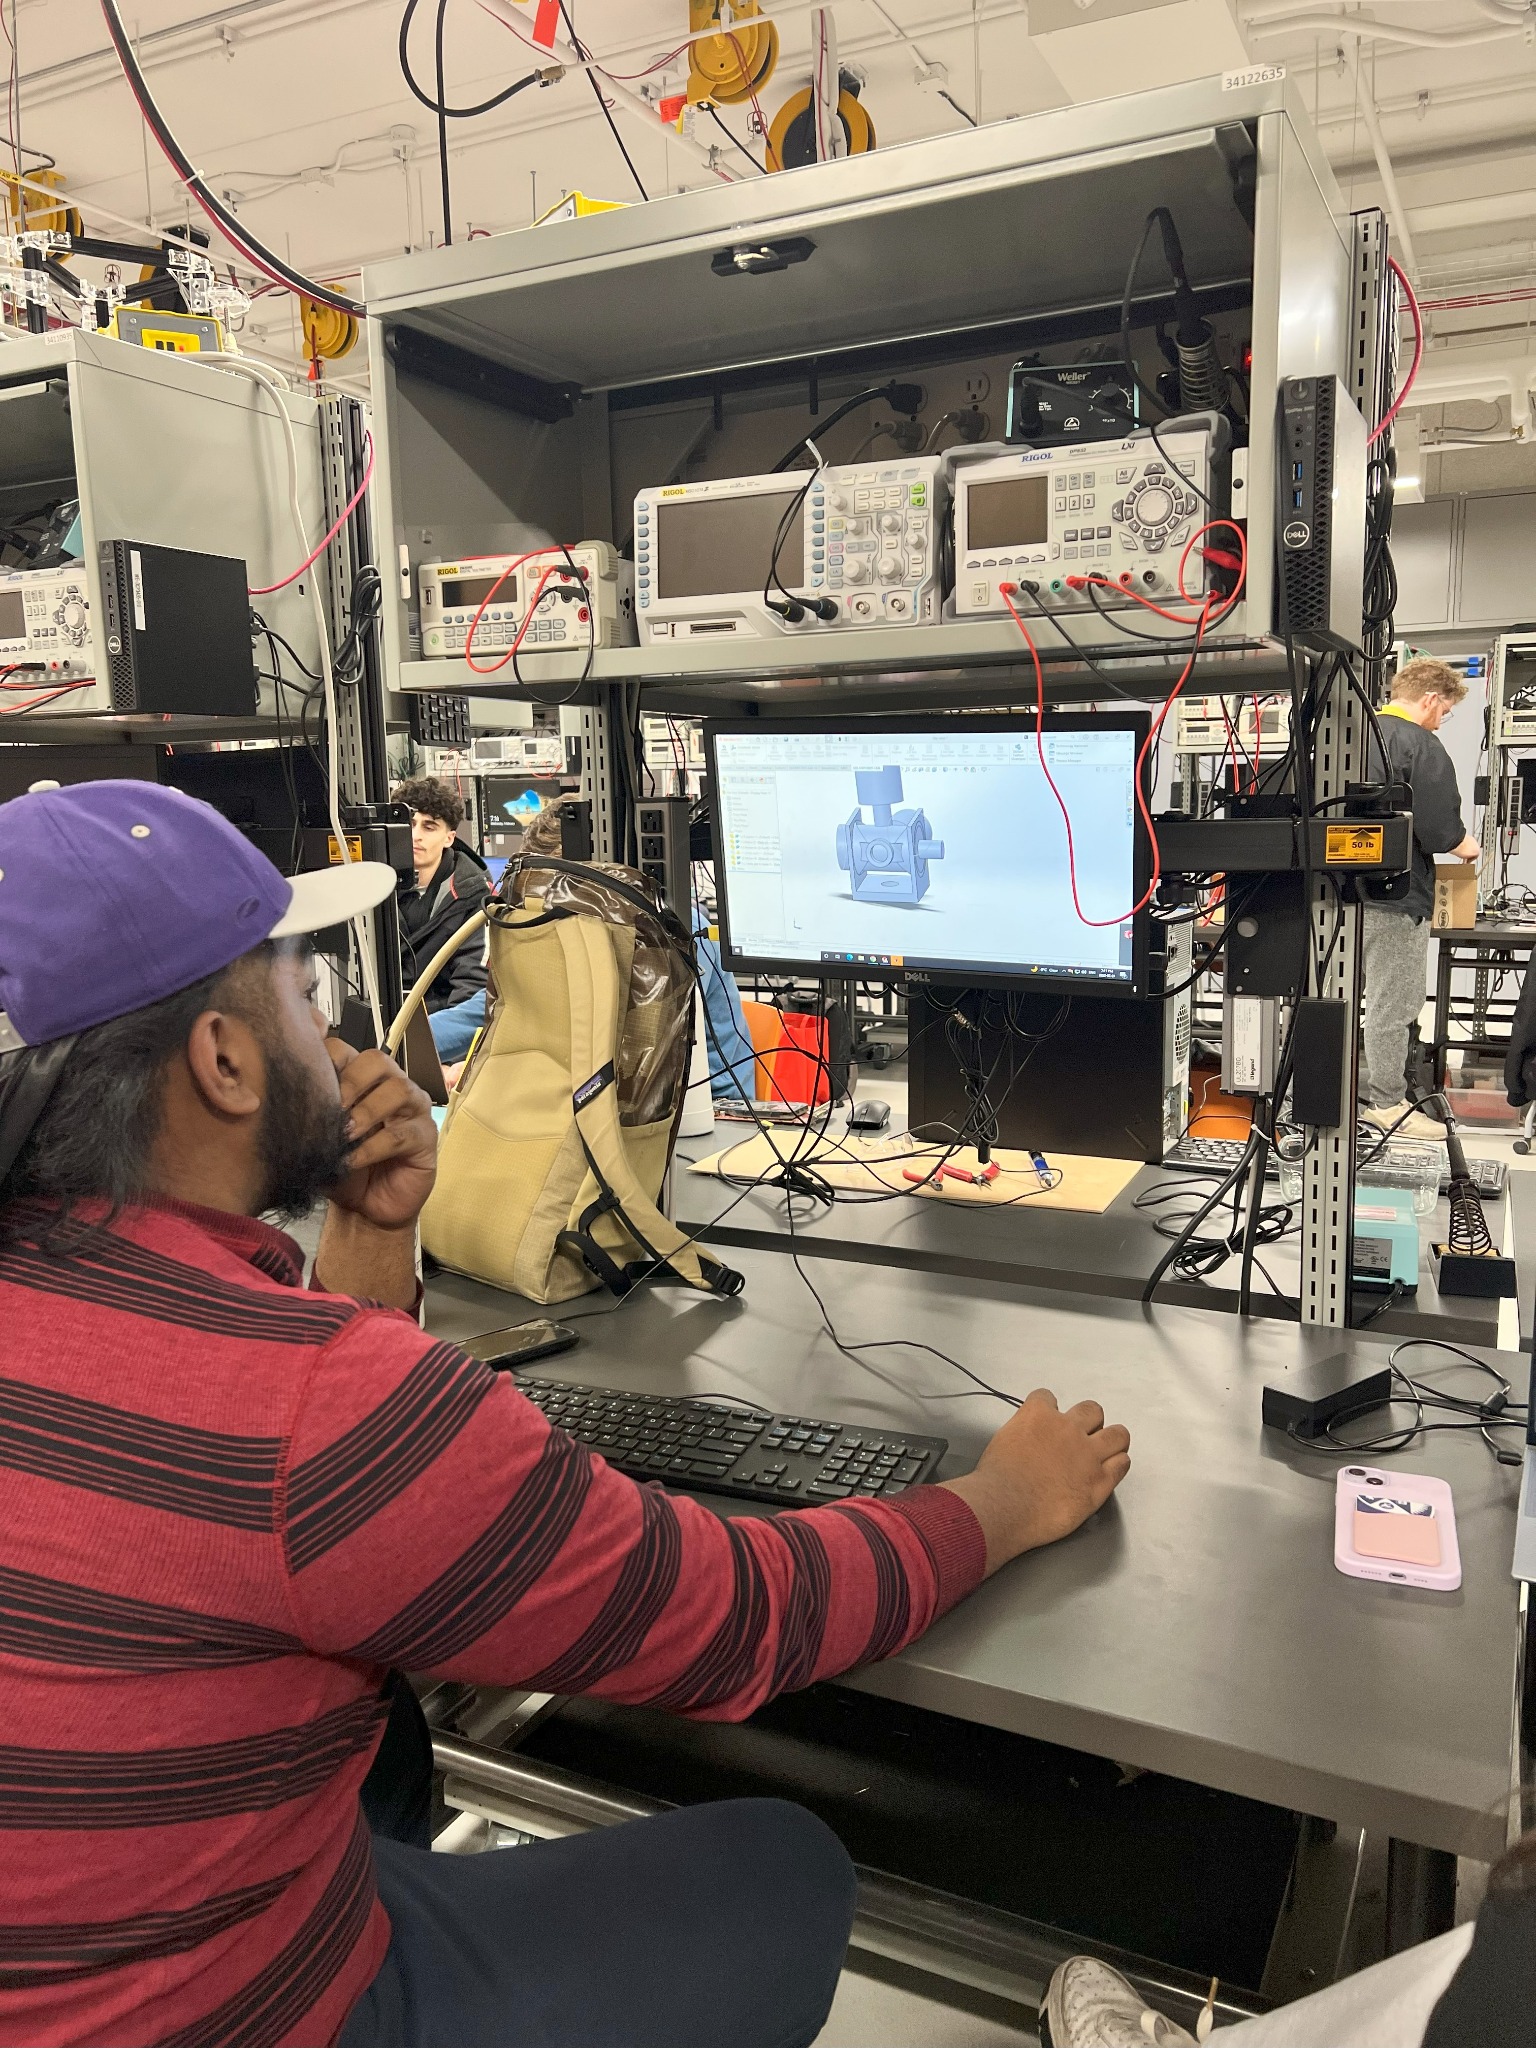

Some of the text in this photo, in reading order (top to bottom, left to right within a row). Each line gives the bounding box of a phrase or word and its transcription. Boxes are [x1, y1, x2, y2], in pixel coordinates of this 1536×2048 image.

[1226, 67, 1283, 89] 34122635
[1058, 372, 1088, 381] Weller
[1021, 452, 1054, 463] RIGOL
[662, 488, 685, 497] RIGOL
[1287, 530, 1307, 539] DELL
[437, 567, 459, 576] RIGOL
[1352, 841, 1363, 849] 50
[904, 971, 931, 983] DELL
